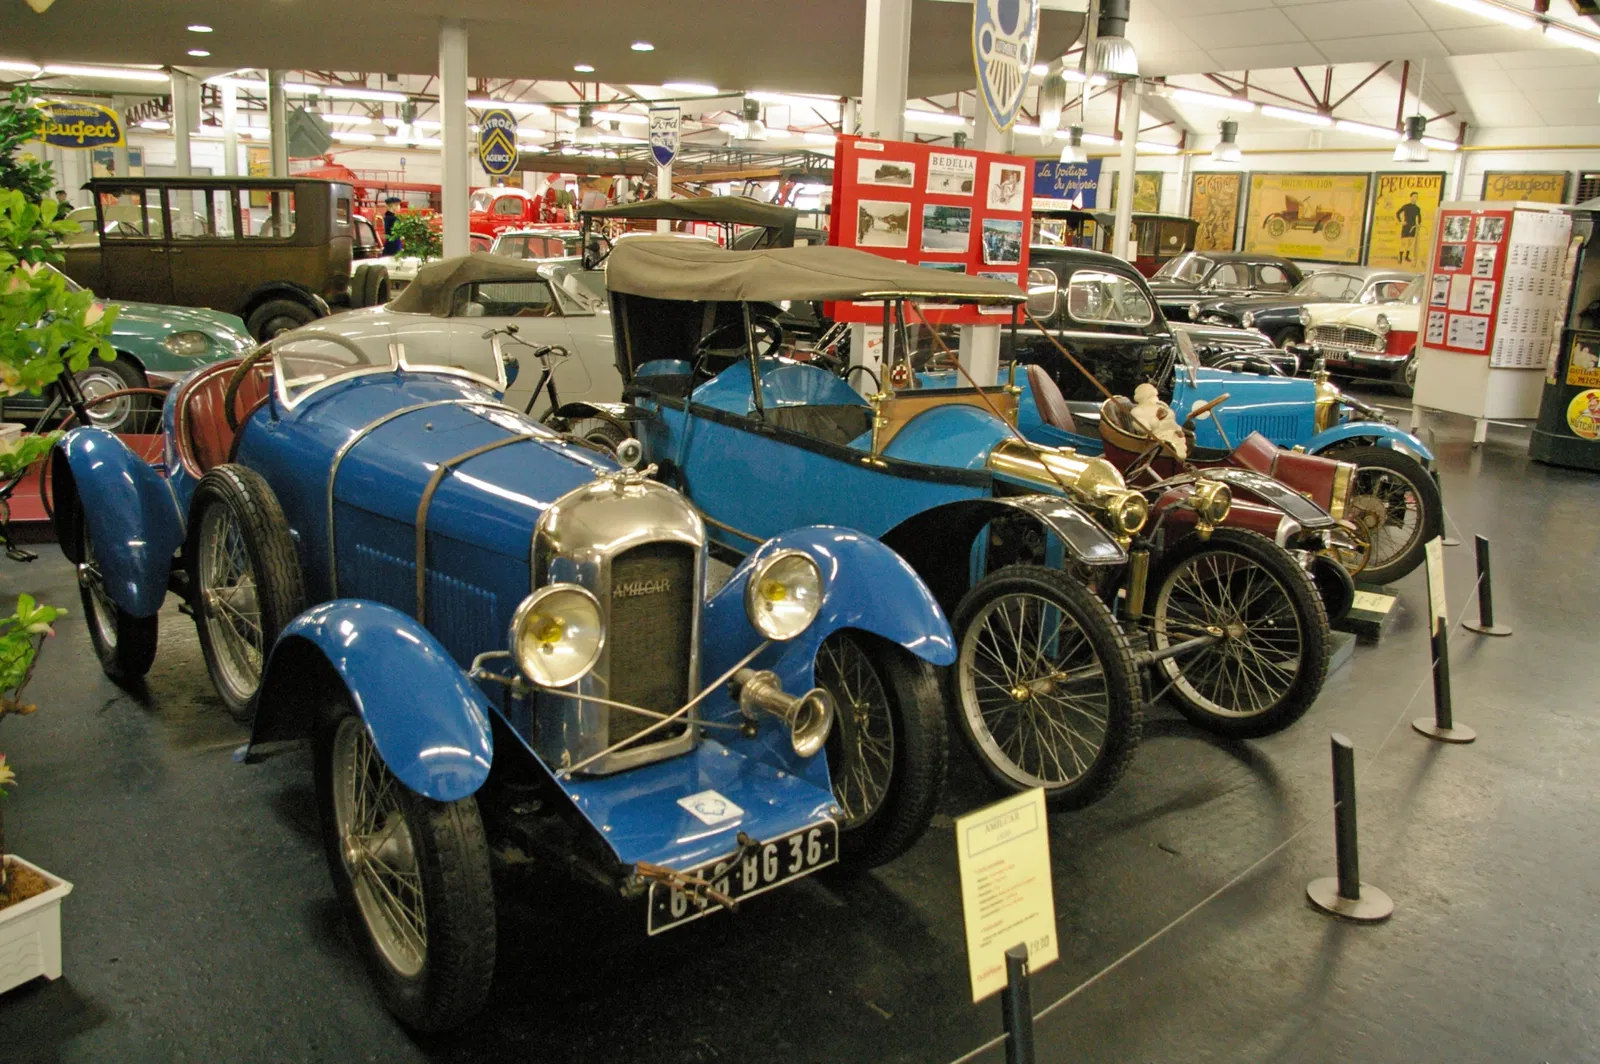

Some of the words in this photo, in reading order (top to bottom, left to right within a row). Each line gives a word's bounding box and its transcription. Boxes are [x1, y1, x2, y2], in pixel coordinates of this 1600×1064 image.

[651, 117, 678, 130] Ford
[486, 154, 510, 162] AGENCE
[932, 156, 974, 170] BEDELIA
[1038, 163, 1051, 178] La
[1063, 180, 1097, 196] prgrès
[1378, 176, 1440, 196] PEUGEOT
[1494, 176, 1557, 197] Peugeot
[613, 579, 671, 598] AMILCAR
[984, 810, 1021, 834] AMILCAR
[742, 843, 778, 892] BG
[788, 828, 822, 874] 36
